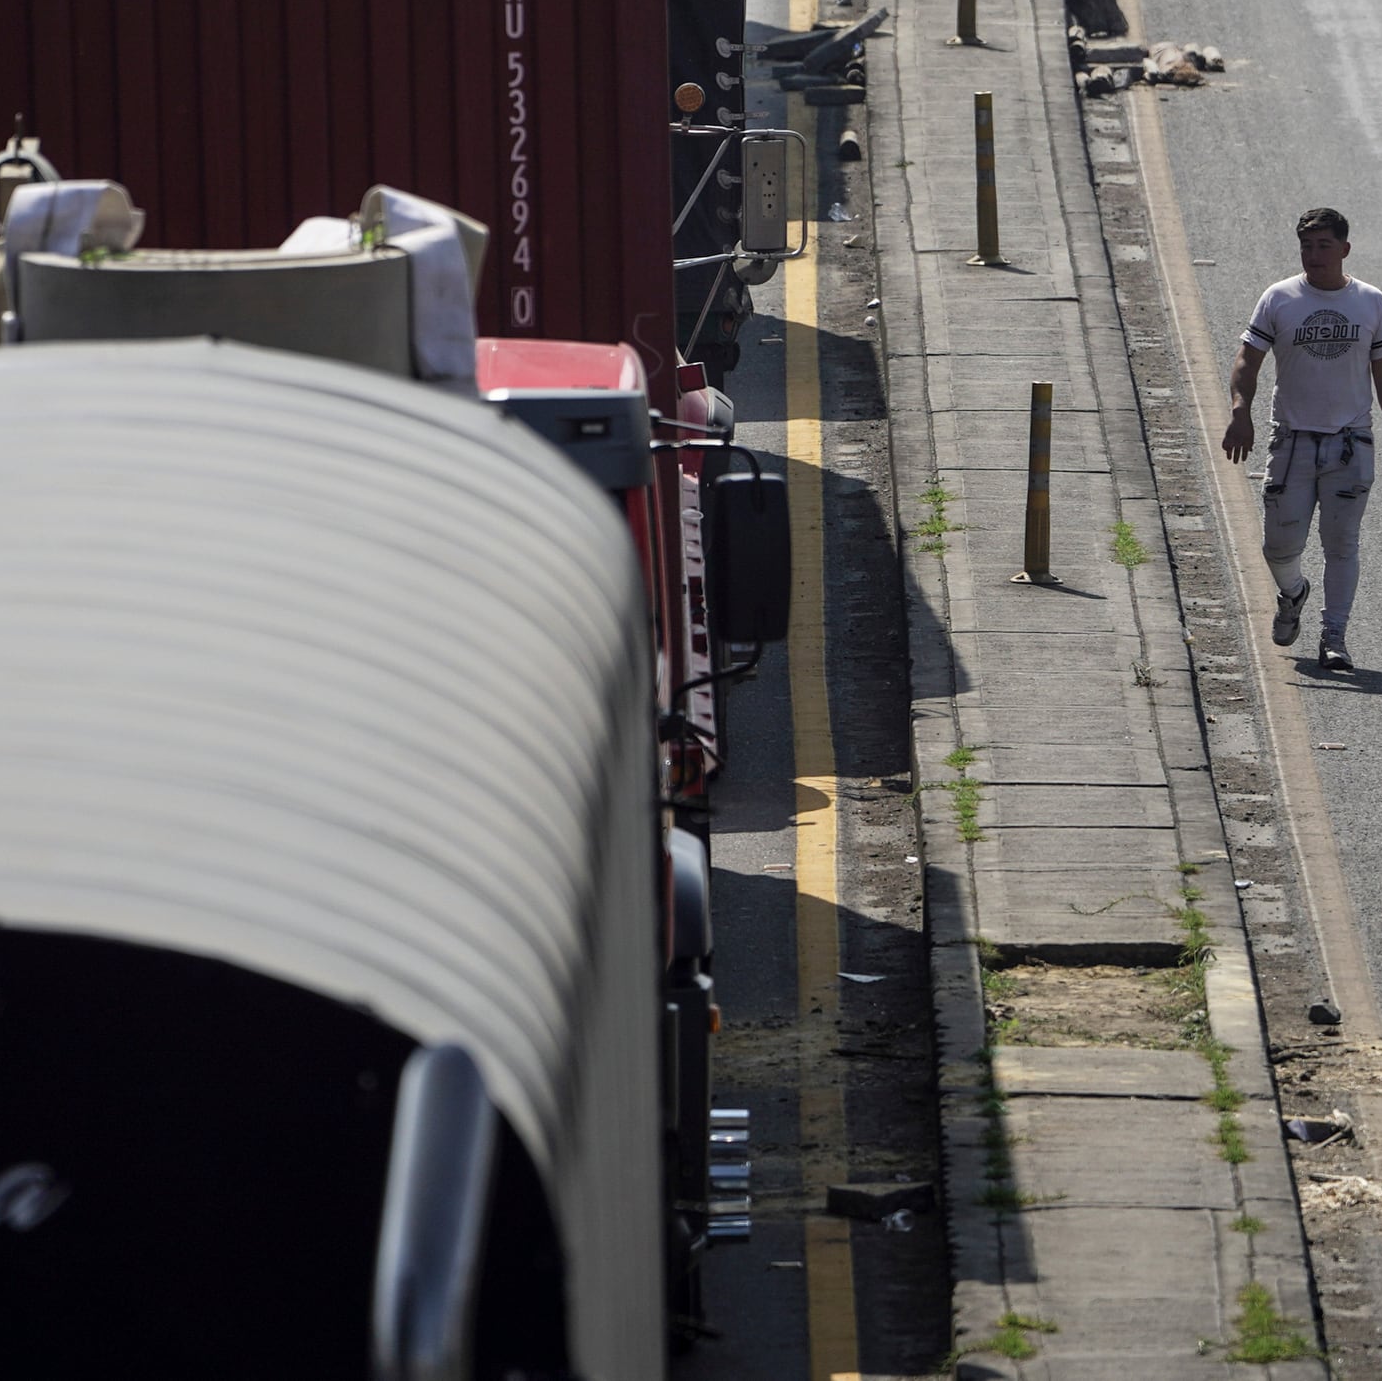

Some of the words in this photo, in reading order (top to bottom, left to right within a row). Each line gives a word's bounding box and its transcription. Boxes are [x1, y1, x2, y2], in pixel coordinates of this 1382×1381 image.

[507, 51, 532, 273] 532694
[514, 289, 533, 324] 0
[1294, 328, 1321, 342] JUST
[1332, 325, 1348, 338] DO
[1351, 325, 1361, 338] IT
